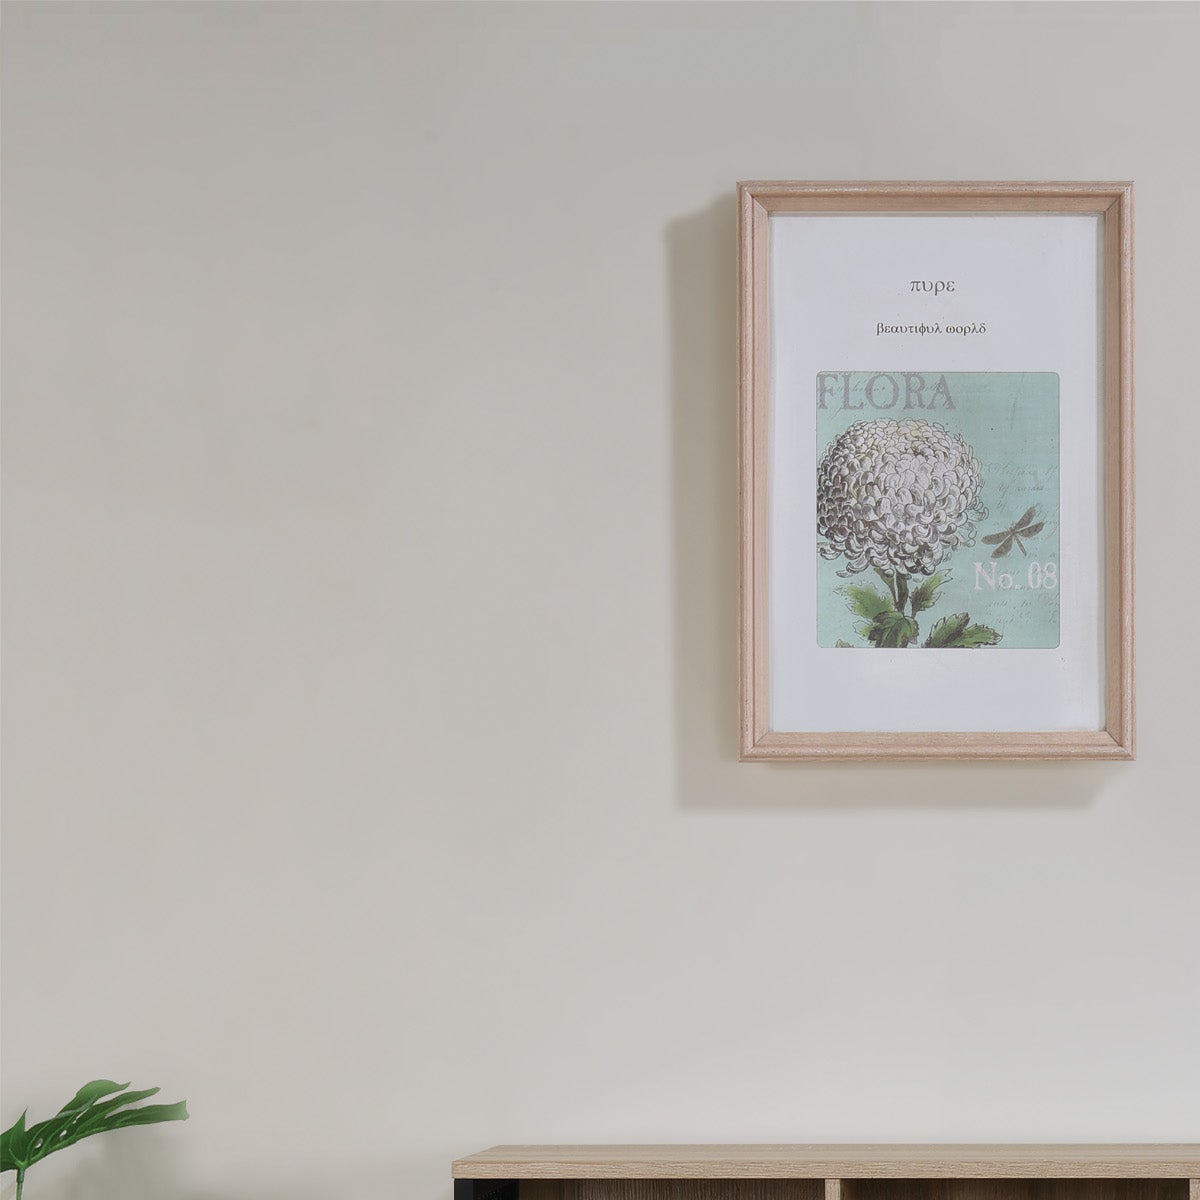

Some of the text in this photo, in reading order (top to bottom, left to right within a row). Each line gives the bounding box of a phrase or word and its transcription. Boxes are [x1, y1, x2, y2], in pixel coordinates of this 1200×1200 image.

[816, 372, 957, 411] FLORA
[973, 561, 1058, 591] No. 08
